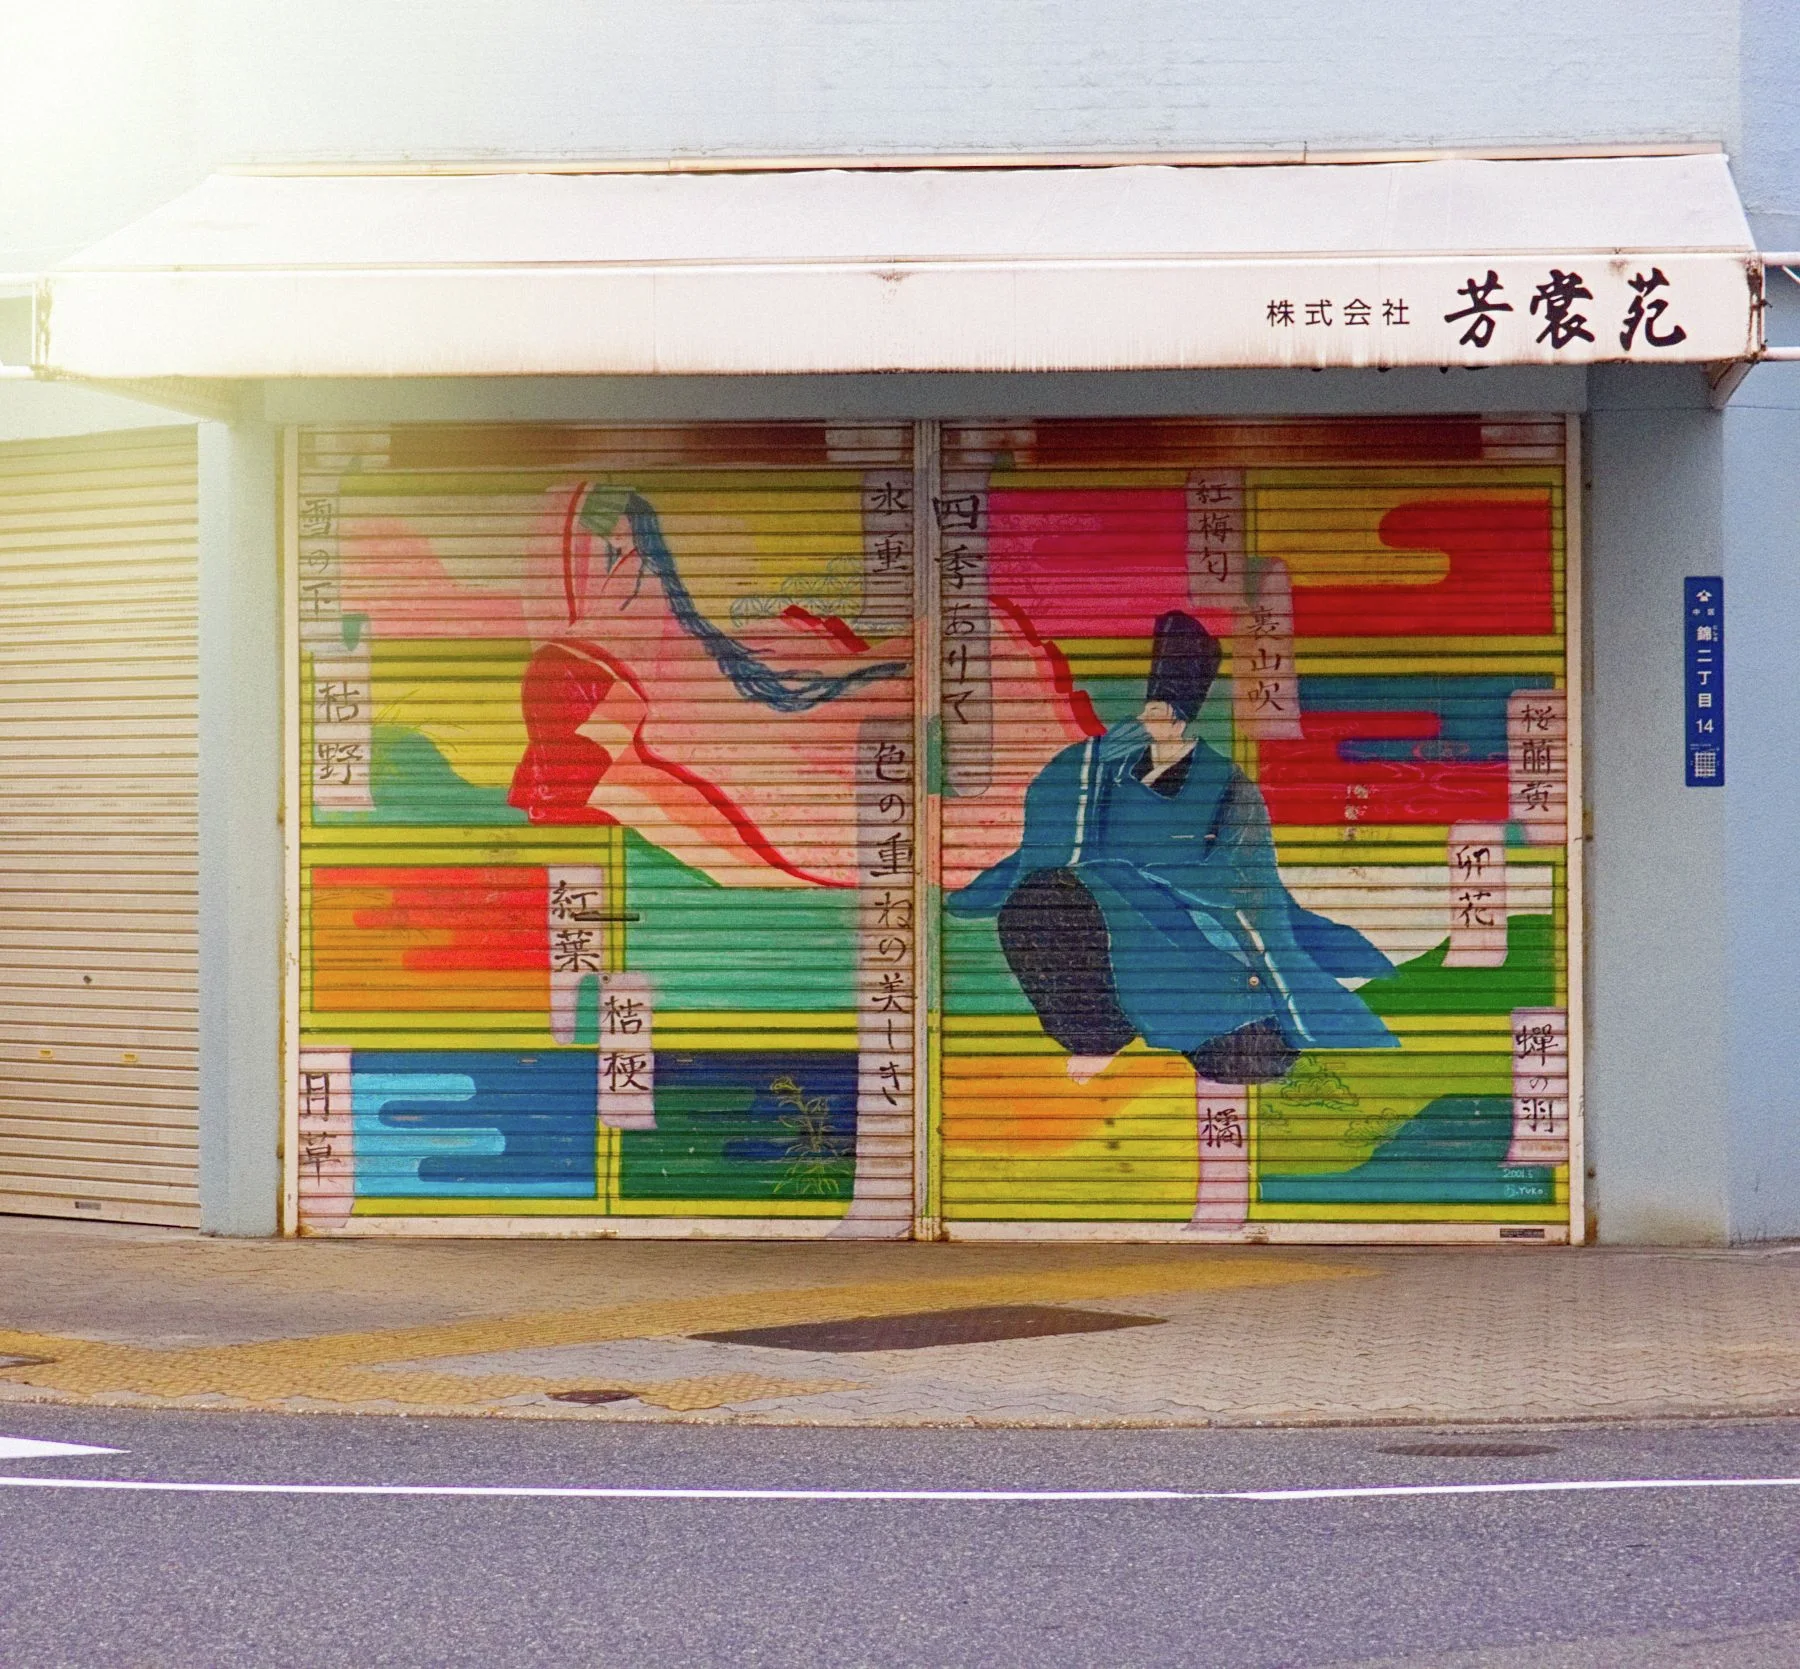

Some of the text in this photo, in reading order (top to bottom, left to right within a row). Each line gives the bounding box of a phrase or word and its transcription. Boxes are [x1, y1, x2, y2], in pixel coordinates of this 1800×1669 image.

[1266, 298, 1411, 328] 株式会社
[932, 494, 983, 725] 四季ありて
[1247, 605, 1285, 712] 裏山吹
[318, 680, 364, 785] 枯野
[551, 879, 600, 973] 紅葉
[869, 741, 918, 1106] 色の重ねの美しき
[1456, 845, 1495, 928] 卯花
[602, 995, 650, 1092] 桔梗
[1200, 1107, 1243, 1149] 橘
